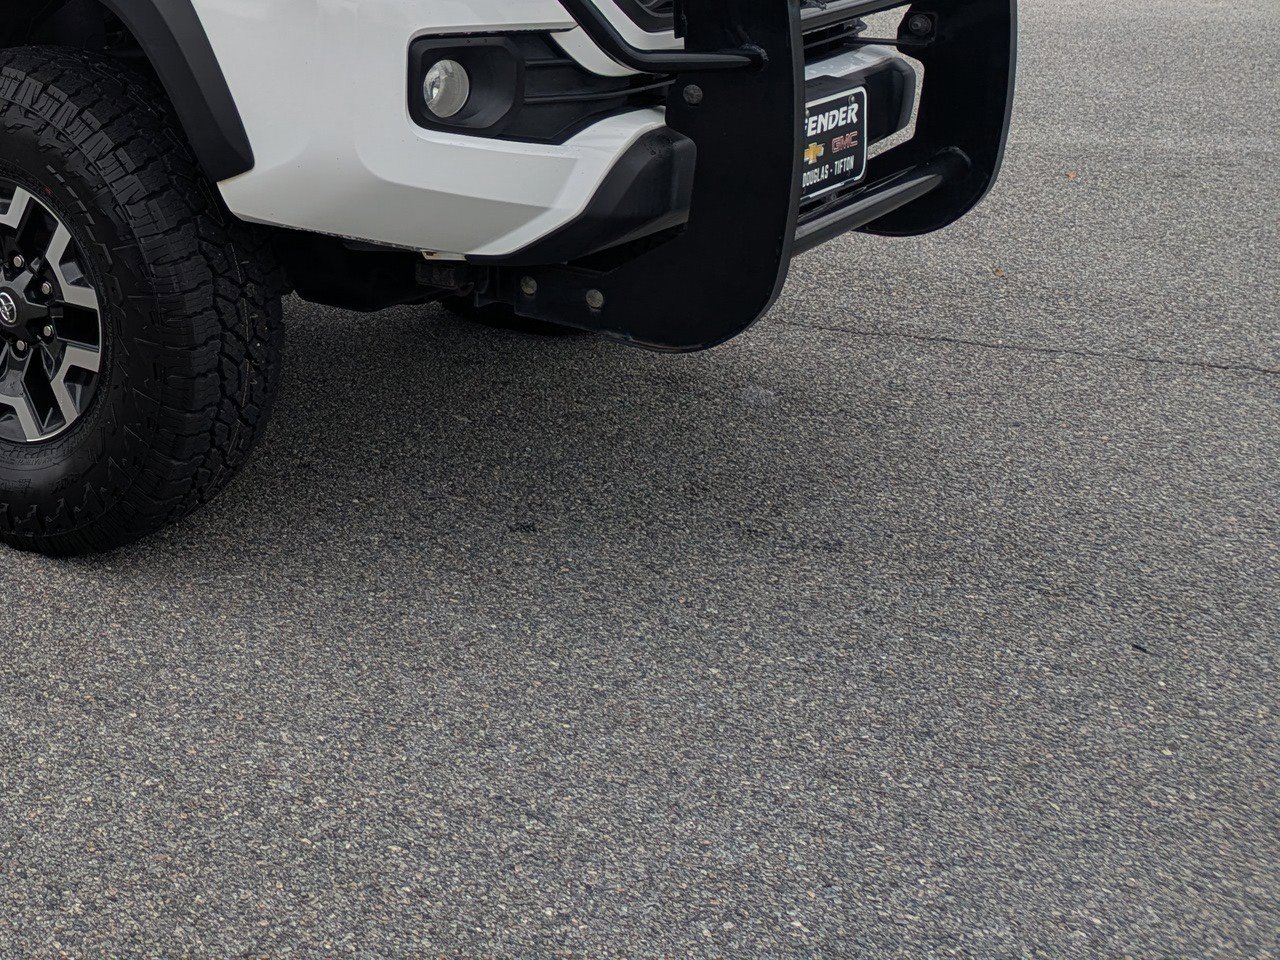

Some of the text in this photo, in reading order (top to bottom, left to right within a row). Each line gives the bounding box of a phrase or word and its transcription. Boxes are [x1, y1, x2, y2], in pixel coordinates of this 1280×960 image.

[805, 103, 859, 137] ENDER
[831, 130, 859, 154] GMC
[802, 164, 829, 188] DOUGLAS
[834, 155, 855, 176] TIFTON
